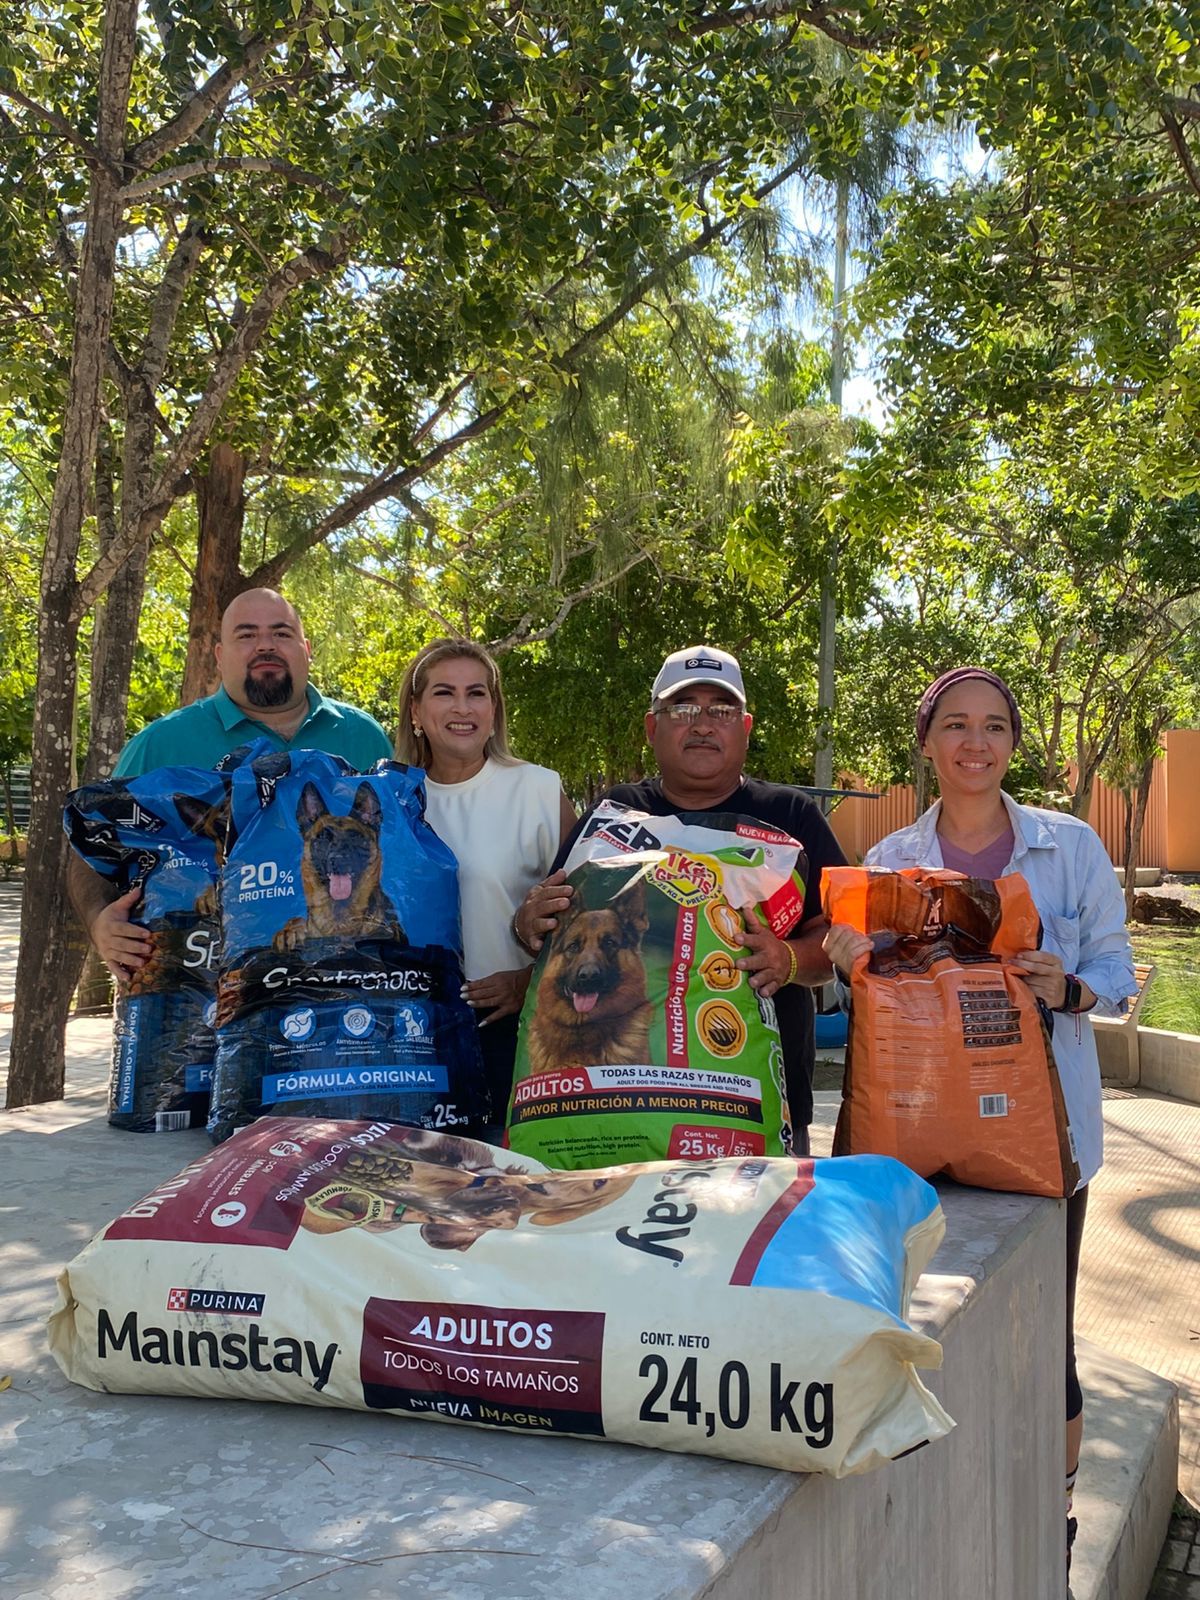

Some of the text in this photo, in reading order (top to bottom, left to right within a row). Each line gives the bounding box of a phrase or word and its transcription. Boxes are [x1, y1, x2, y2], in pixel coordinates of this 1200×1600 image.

[240, 861, 294, 890] 20%
[238, 884, 295, 903] PROTEÍNA
[682, 912, 694, 941] nota
[772, 912, 790, 932] 25
[681, 944, 691, 960] se
[671, 986, 685, 1056] Nutrición
[121, 1056, 133, 1106] ORIGINAL
[276, 1070, 436, 1092] FÓRMULA ORIGINAL
[600, 1068, 752, 1088] TODAS LAS RAZAS Y TAMAÑOS
[514, 1077, 585, 1105] ADULTOS
[434, 1103, 459, 1128] 25
[519, 1095, 749, 1120] ¡MAYOR NUTRICIÓN A MENOR PRECIO!
[684, 1130, 703, 1138] Cont.
[679, 1140, 726, 1159] 25 Kg
[189, 1292, 259, 1312] PURINA
[409, 1315, 553, 1351] ADULTOS
[639, 1331, 710, 1350] CONT. NETO
[97, 1308, 339, 1393] Mainstay
[383, 1350, 580, 1395] TODOS LOS TAMAÑOS
[638, 1353, 835, 1450] 24,0 kg
[479, 1404, 553, 1428] IMAGEN
